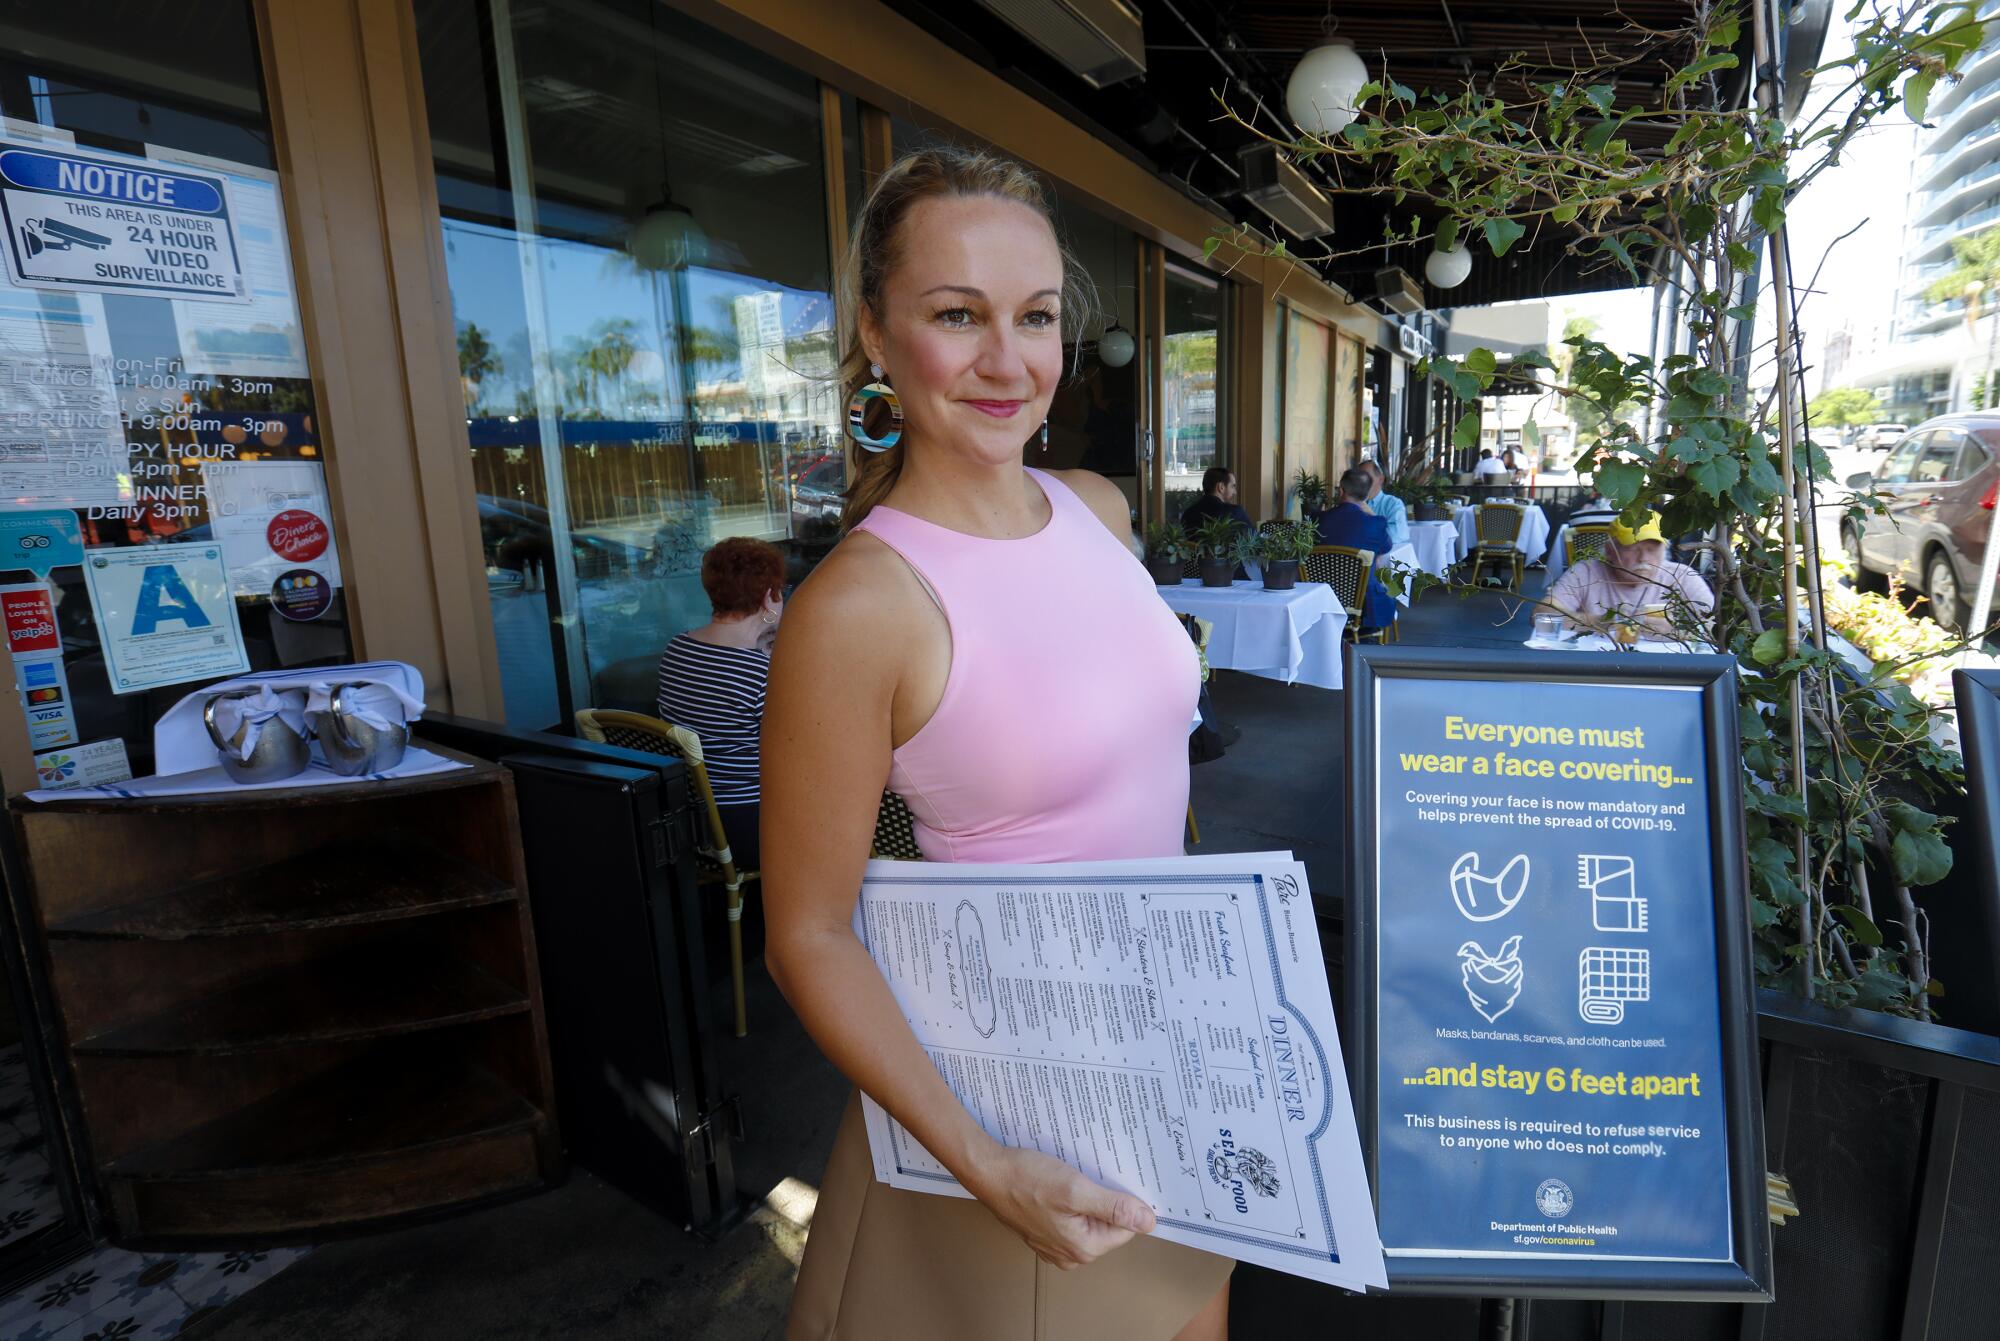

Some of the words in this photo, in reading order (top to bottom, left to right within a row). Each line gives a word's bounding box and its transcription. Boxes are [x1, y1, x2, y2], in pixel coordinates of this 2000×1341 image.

[59, 162, 175, 205] NOTICE
[65, 202, 101, 218] THIS
[106, 207, 144, 224] AREA
[148, 213, 161, 225] IS
[166, 215, 214, 232] UNDER
[127, 226, 153, 244] 24
[161, 230, 218, 251] HOUR
[145, 248, 209, 270] VIDEO
[95, 264, 226, 288] SURVEILLANCE
[118, 375, 210, 391] 11:00am
[231, 379, 273, 395] 3pm
[136, 397, 154, 411] &
[159, 399, 201, 414] Sun
[16, 411, 133, 429] BRUNCH
[142, 415, 221, 432] 9:00am
[242, 417, 283, 434] 3pm
[71, 442, 160, 458] HAPPY
[167, 443, 236, 458] HOUR
[132, 461, 180, 477] 4pm
[137, 485, 208, 501] INNER
[88, 505, 145, 522] Daily
[152, 504, 199, 520] 3pm
[8, 601, 46, 609] PEOPLE
[131, 564, 212, 636] A
[8, 609, 33, 618] LOVE
[35, 608, 48, 616] US
[13, 628, 40, 640] yelp
[35, 710, 63, 720] VISA
[1445, 716, 1574, 748] Everyone
[1579, 726, 1644, 749] must
[1400, 754, 1467, 774] wear
[1472, 756, 1488, 775] a
[1495, 752, 1555, 778] face
[1559, 759, 1693, 788] covering...
[1406, 790, 1468, 808] Covering
[1471, 795, 1503, 808] your
[1507, 795, 1539, 809] face
[1542, 797, 1553, 810] is
[1557, 799, 1585, 811] now
[1589, 800, 1658, 815] mandatory
[1660, 803, 1685, 815] and
[1419, 808, 1456, 823] helps
[1459, 810, 1514, 825] prevent
[1517, 813, 1541, 826] the
[1544, 815, 1592, 829] spread
[1595, 817, 1609, 829] of
[1612, 817, 1677, 831] COVID-19.
[1269, 873, 1301, 905] Parc
[1204, 910, 1212, 929] JUMBO
[1214, 910, 1228, 935] Fresh
[1164, 924, 1173, 947] CEVICHE
[1189, 930, 1198, 954] OYSTERS
[1207, 930, 1216, 952] SHRIMP
[1282, 909, 1300, 963] Bistro-Brasserie
[1211, 953, 1222, 980] COCKTAIL
[1217, 938, 1236, 976] Seafood
[947, 972, 958, 997] Salad
[1135, 938, 1151, 974] Starters
[1144, 987, 1160, 1019] Shares
[1140, 1003, 1148, 1027] BURRATA
[1436, 1028, 1470, 1040] Masks,
[1471, 1030, 1522, 1043] bandanas,
[1523, 1034, 1565, 1045] scarves,
[1567, 1035, 1586, 1046] and
[1586, 1036, 1611, 1047] cloth
[1612, 1038, 1631, 1048] can
[1631, 1037, 1642, 1048] be
[1643, 1038, 1667, 1048] used.
[1246, 1037, 1262, 1071] Seafood
[1266, 1014, 1306, 1124] DINNER
[1403, 1062, 1477, 1087] ...and
[1481, 1064, 1541, 1095] stay
[1546, 1067, 1566, 1091] 6
[1571, 1068, 1626, 1095] feet
[1631, 1072, 1700, 1099] apart
[1253, 1072, 1268, 1099] Towers
[1404, 1114, 1435, 1128] This
[1438, 1115, 1501, 1130] business
[1504, 1117, 1517, 1131] is
[1520, 1119, 1582, 1135] required
[1586, 1122, 1600, 1136] to
[1604, 1123, 1646, 1137] refuse
[1648, 1125, 1700, 1139] service
[1204, 1147, 1217, 1165] DAILY
[1440, 1134, 1454, 1148] to
[1458, 1137, 1509, 1151] anyone
[1514, 1138, 1543, 1150] who
[1546, 1139, 1584, 1153] does
[1587, 1141, 1610, 1154] not
[1613, 1142, 1667, 1157] comply.
[1207, 1164, 1221, 1185] FRESH
[1218, 1128, 1236, 1158] SEA
[1229, 1179, 1248, 1214] FOOD
[1491, 1221, 1545, 1234] Department
[1547, 1223, 1556, 1233] of
[1558, 1224, 1586, 1234] Public
[1587, 1225, 1617, 1236] Health
[1513, 1234, 1595, 1246] sf.gov/coronavirus
